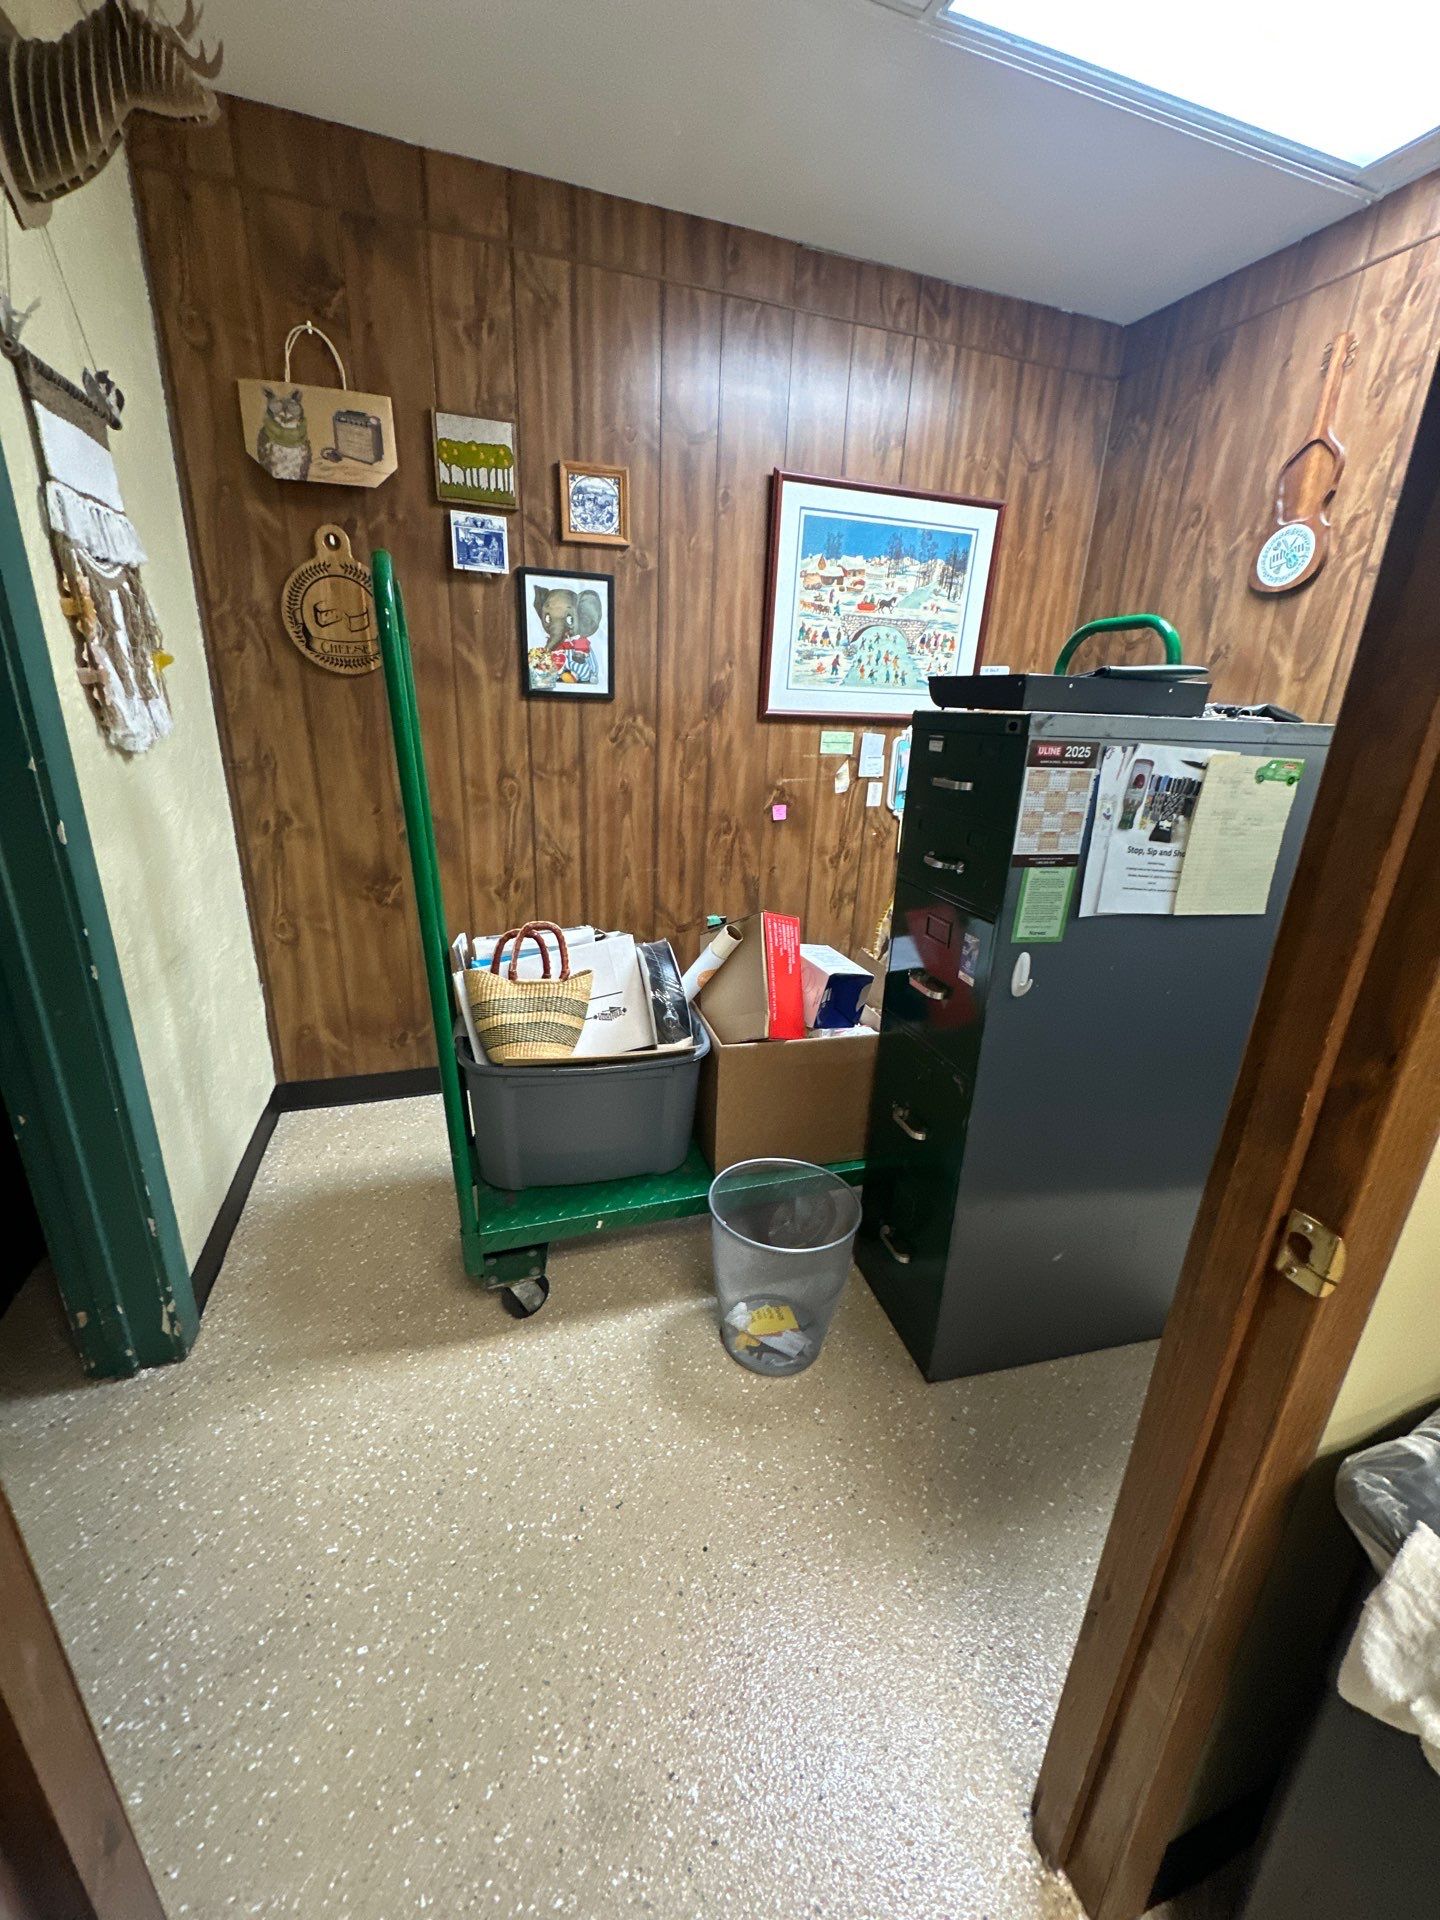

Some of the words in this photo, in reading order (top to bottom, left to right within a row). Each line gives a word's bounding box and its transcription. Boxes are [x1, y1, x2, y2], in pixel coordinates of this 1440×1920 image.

[1037, 746, 1061, 755] ULINE
[1064, 745, 1092, 758] 2025
[1127, 846, 1145, 856] Stop,
[1146, 847, 1157, 857] Sip
[1159, 848, 1172, 857] and
[1173, 849, 1186, 858] Sho
